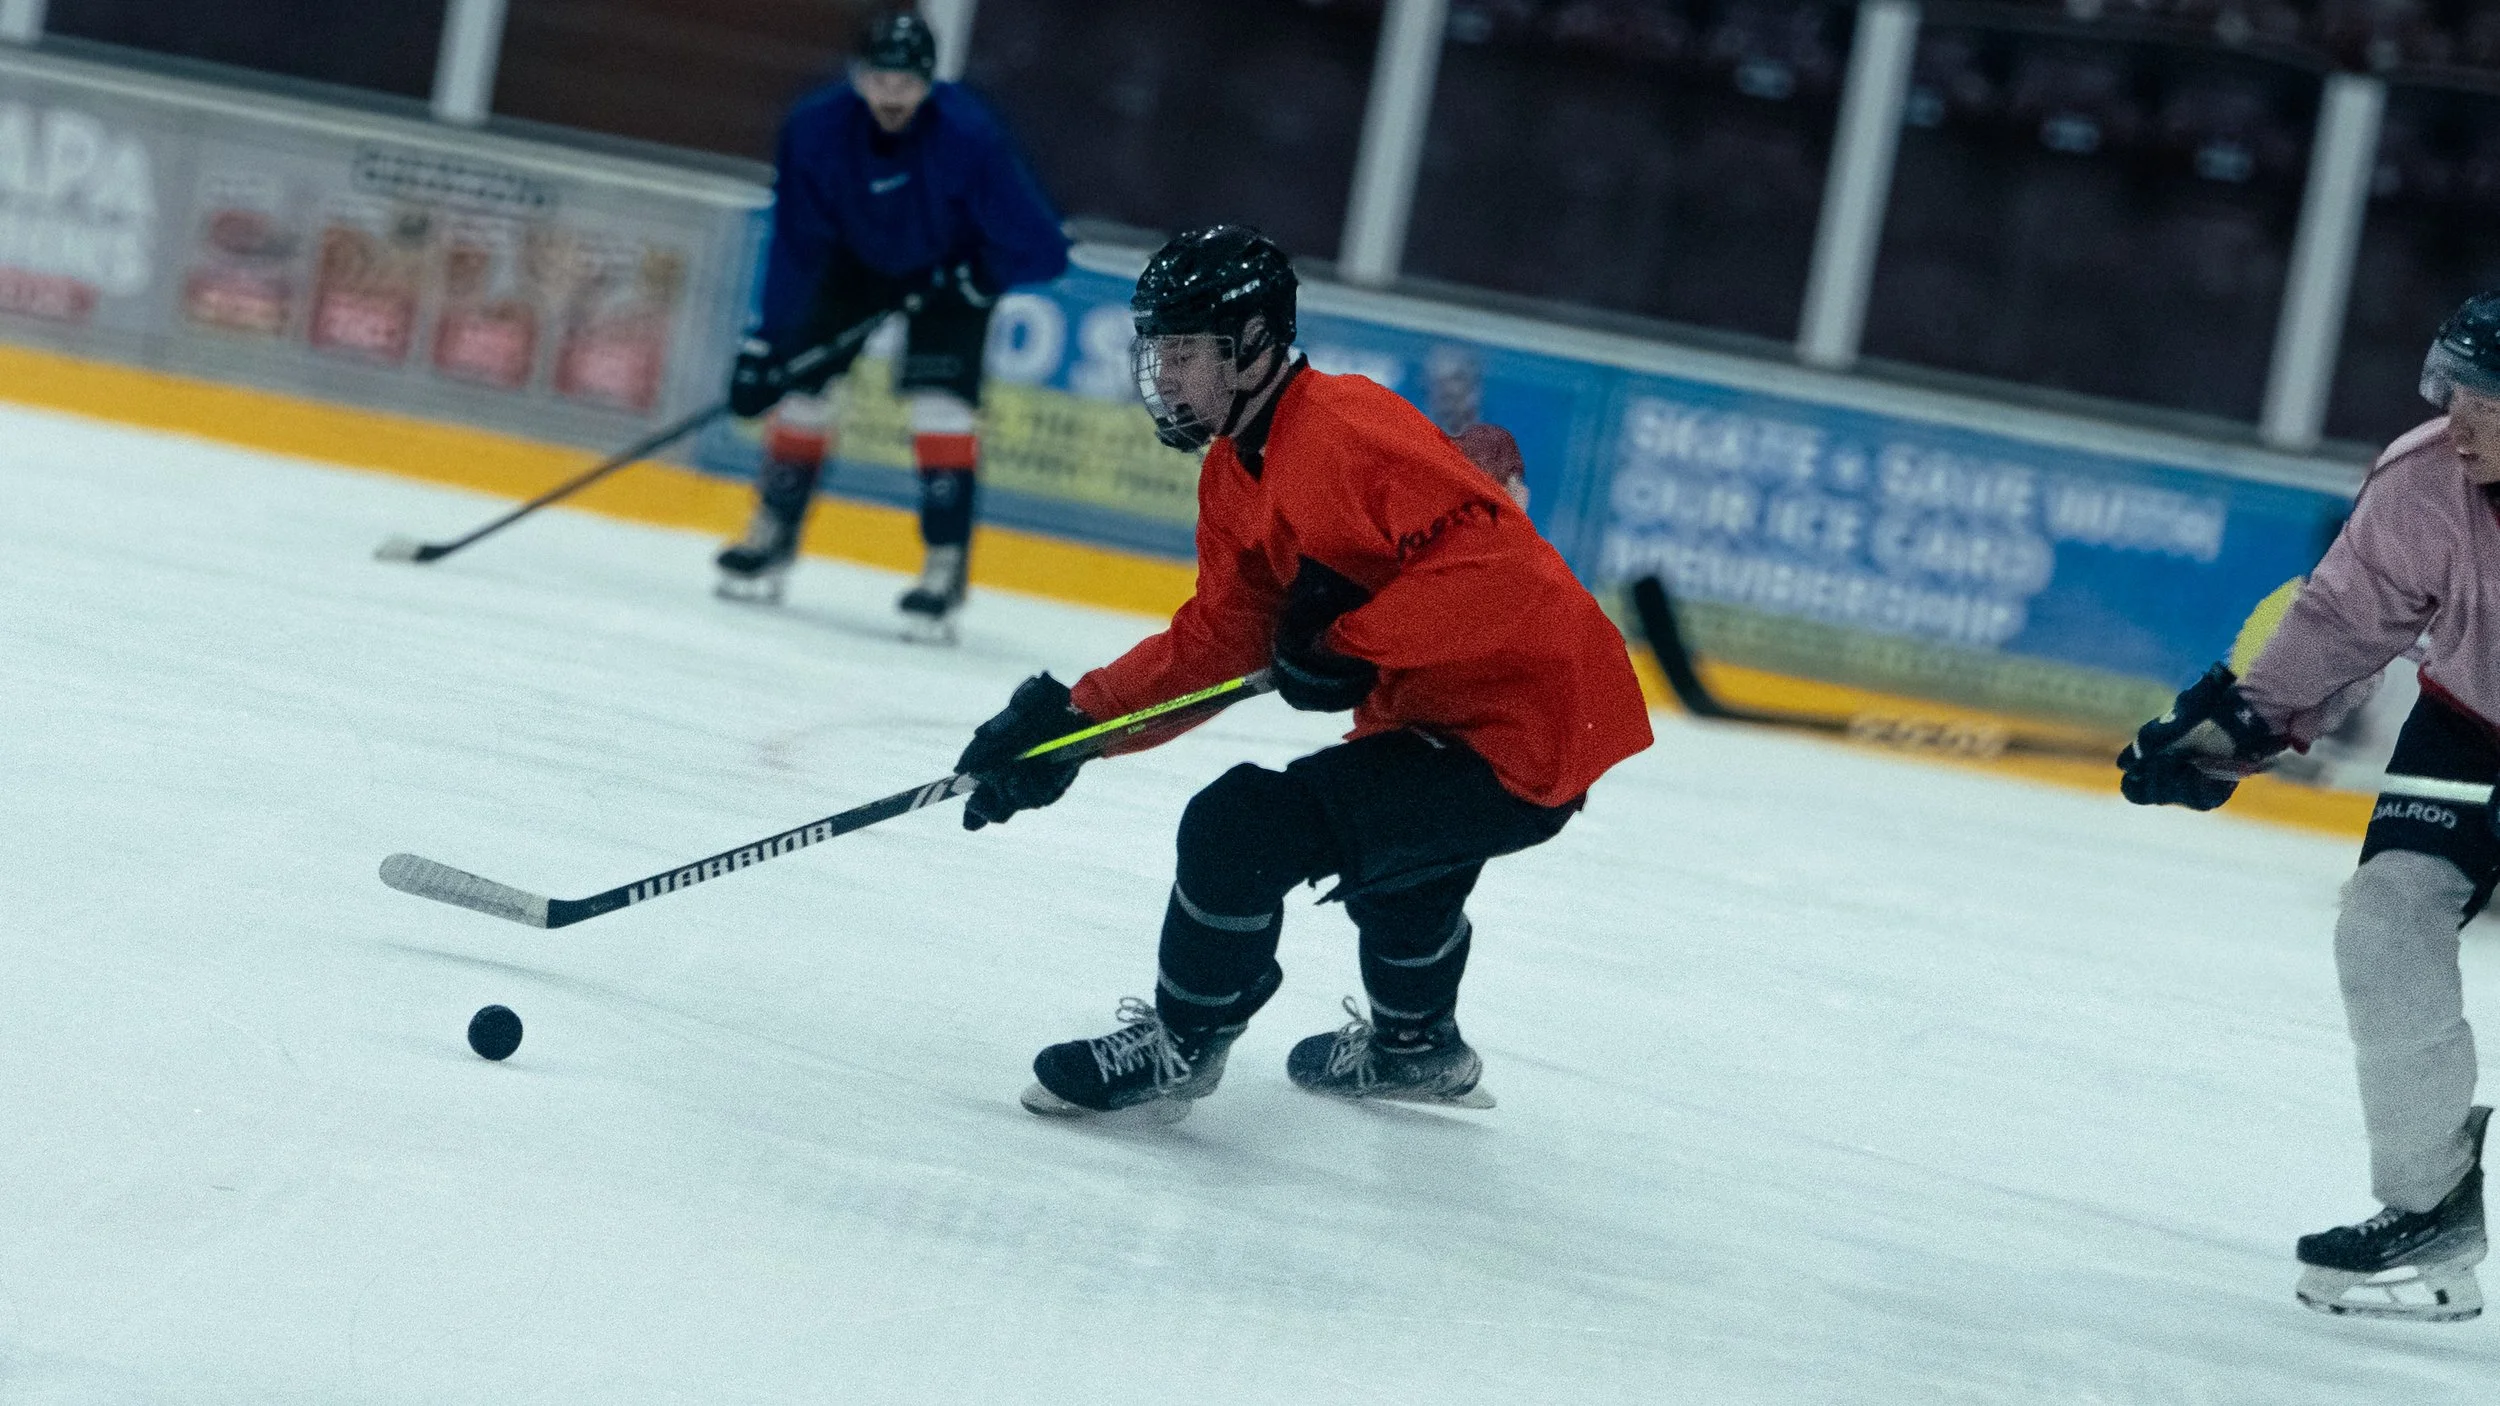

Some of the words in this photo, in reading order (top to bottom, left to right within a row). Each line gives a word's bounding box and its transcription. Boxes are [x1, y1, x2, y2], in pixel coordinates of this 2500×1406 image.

[1622, 398, 1828, 483] SKATE
[1874, 445, 2038, 523] SAVE
[1612, 468, 1758, 540] OUR
[1767, 492, 1864, 556] ICE
[627, 821, 835, 906] WARRIOR
